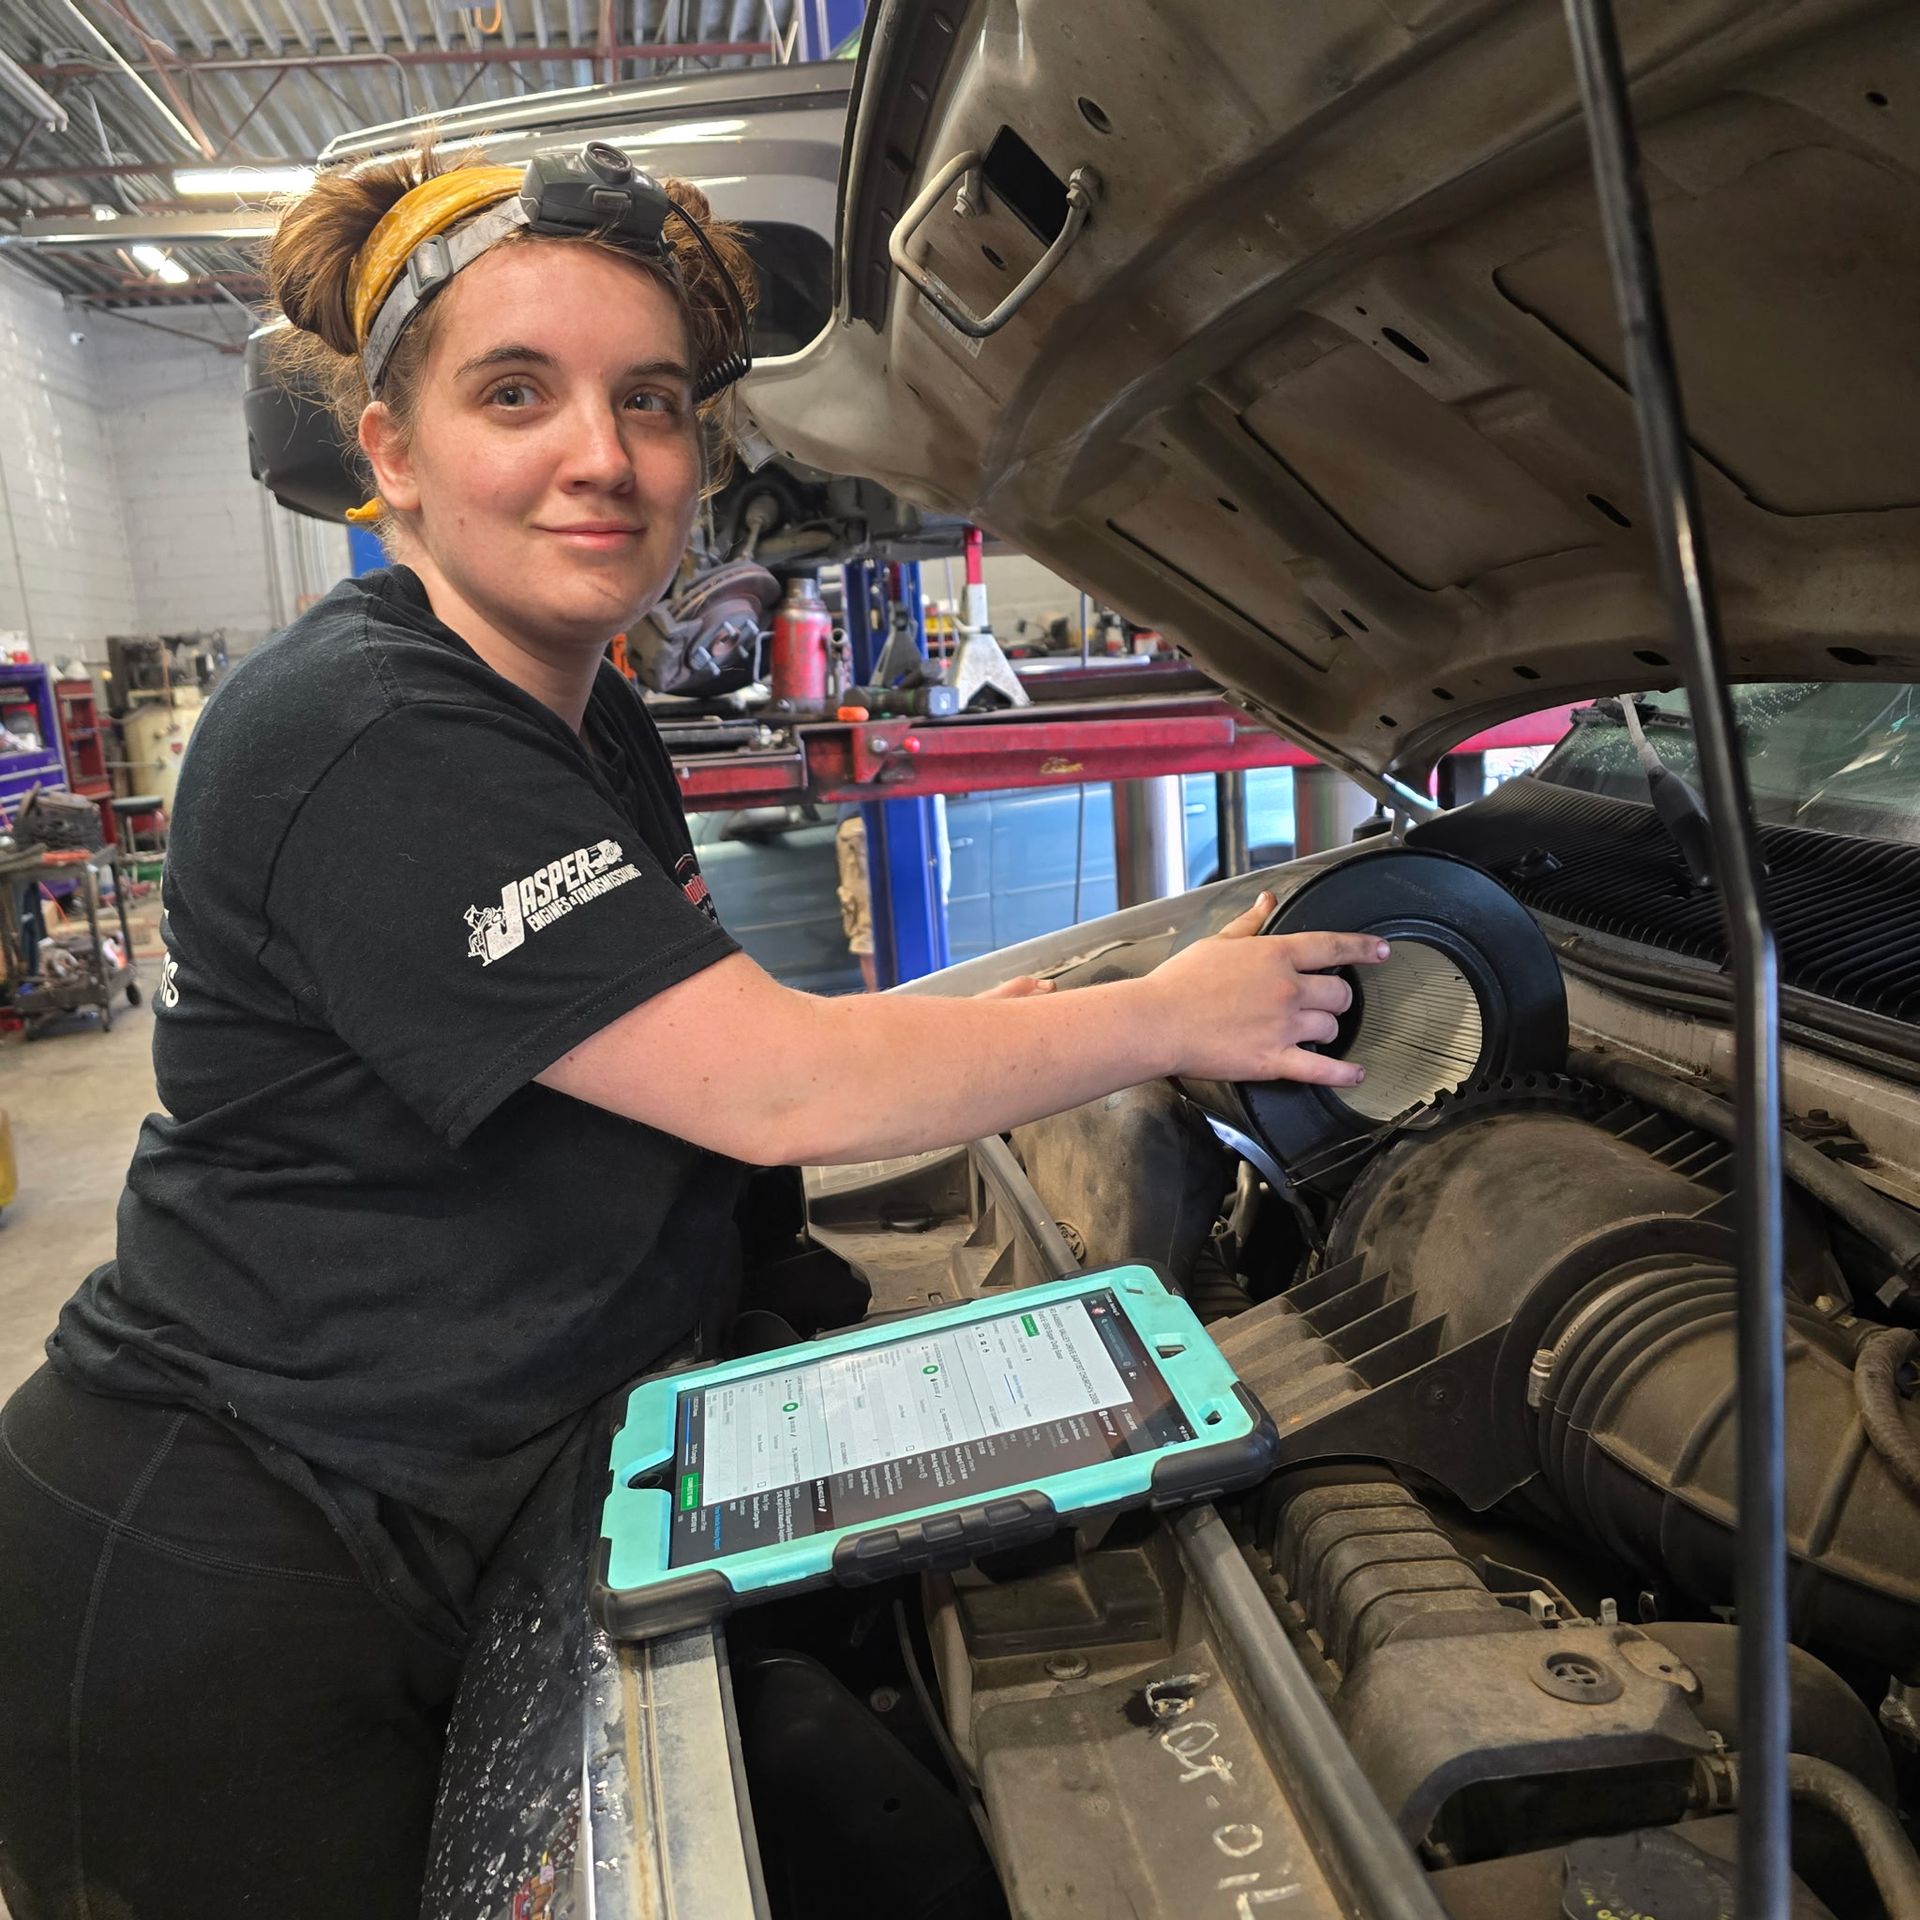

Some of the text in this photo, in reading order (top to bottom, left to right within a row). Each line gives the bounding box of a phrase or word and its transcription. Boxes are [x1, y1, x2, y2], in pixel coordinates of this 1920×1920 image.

[484, 848, 596, 960] JASPER
[526, 896, 574, 933] ENGINES
[573, 863, 643, 906] TRANSMISSIONS
[1057, 1328, 1070, 1342] VALLEY
[1063, 1342, 1077, 1356] DRIVE
[1070, 1355, 1084, 1371] BAPTIST
